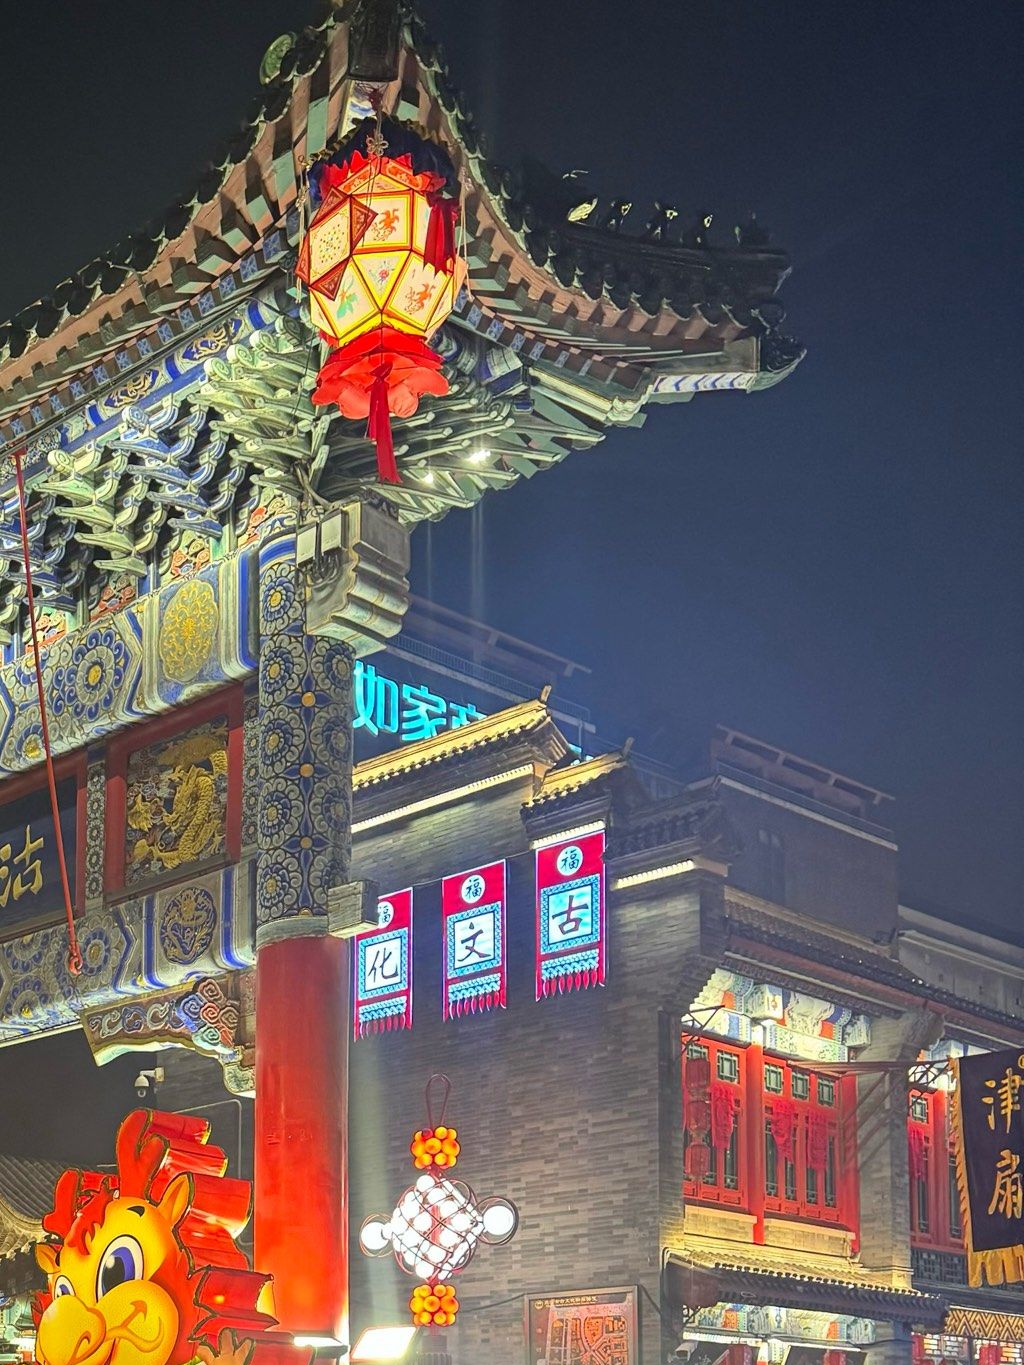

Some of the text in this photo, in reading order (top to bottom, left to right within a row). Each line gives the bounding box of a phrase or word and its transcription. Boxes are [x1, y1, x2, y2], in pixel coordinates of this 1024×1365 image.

[561, 850, 583, 870] 福
[464, 878, 482, 898] 福
[551, 894, 589, 936] 古
[457, 921, 492, 963] 文
[367, 946, 399, 983] 化
